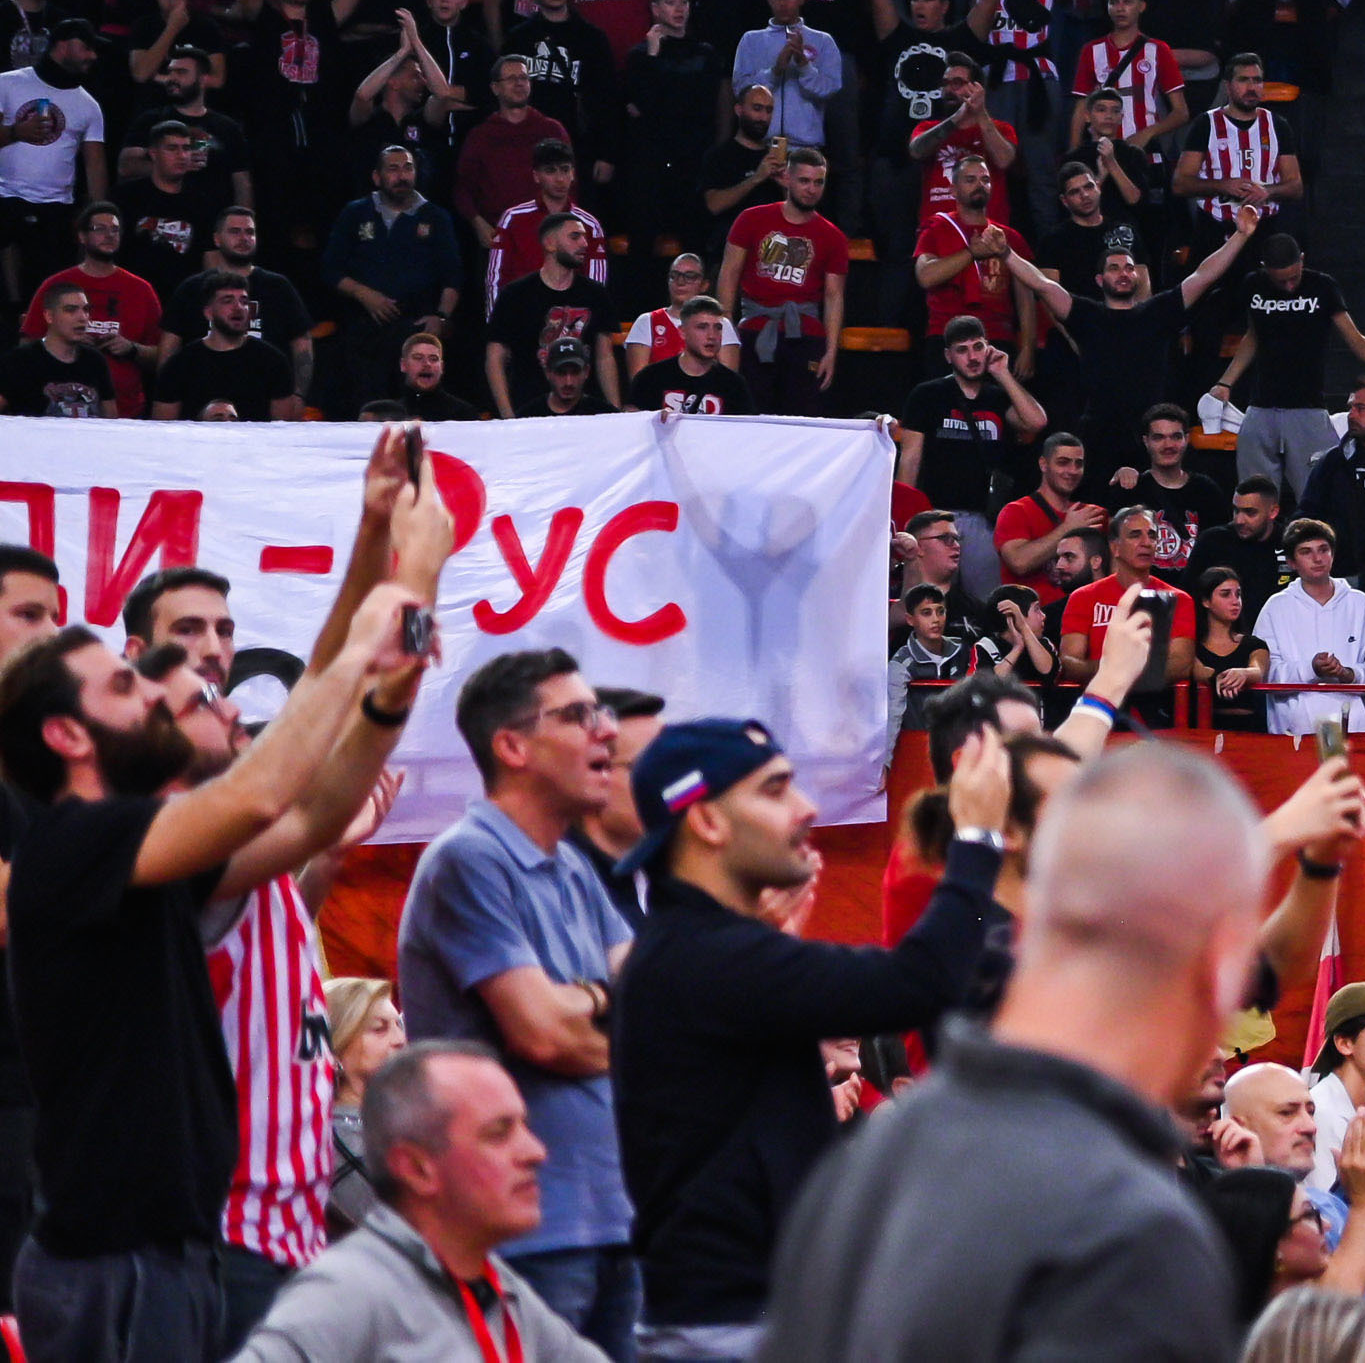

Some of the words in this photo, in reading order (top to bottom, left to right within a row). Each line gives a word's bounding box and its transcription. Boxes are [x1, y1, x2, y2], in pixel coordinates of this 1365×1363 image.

[1237, 148, 1255, 170] 15
[1250, 294, 1321, 315] Superdry.
[943, 418, 985, 431] DIVISN
